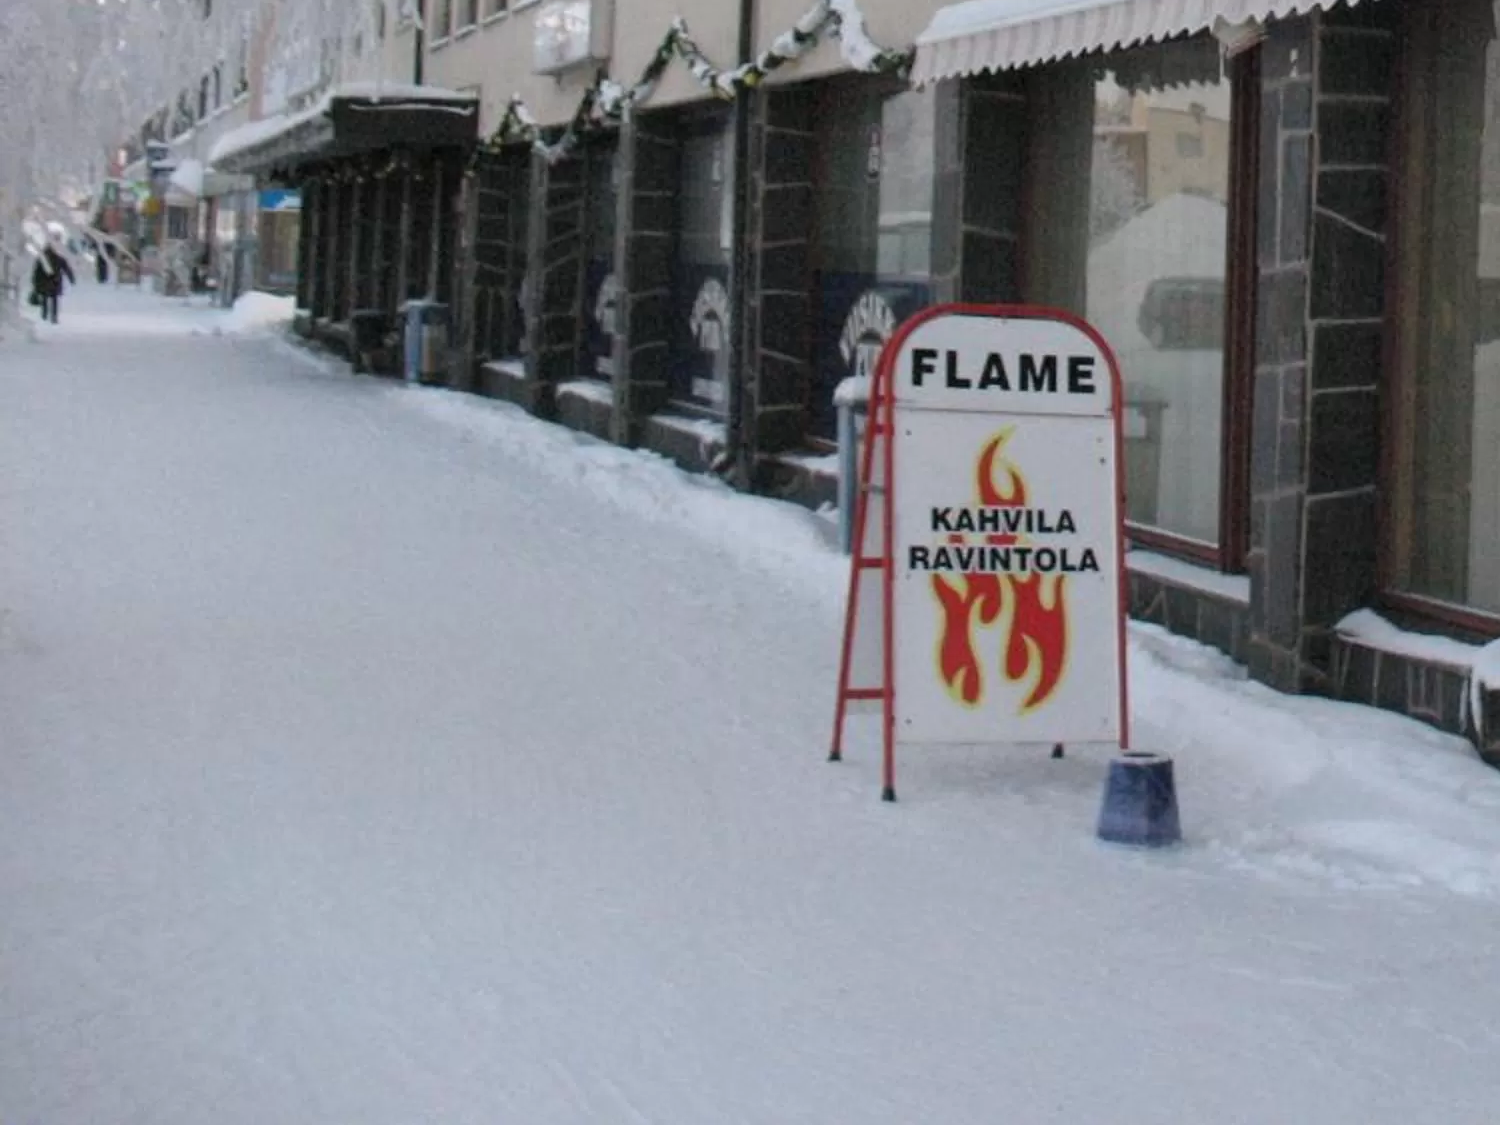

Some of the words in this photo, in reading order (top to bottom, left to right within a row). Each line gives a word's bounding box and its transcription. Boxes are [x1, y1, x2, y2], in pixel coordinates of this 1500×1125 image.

[911, 348, 1097, 395] FLAME
[931, 506, 1077, 534] KAHVILA
[908, 545, 1100, 573] RAVINTOLA
